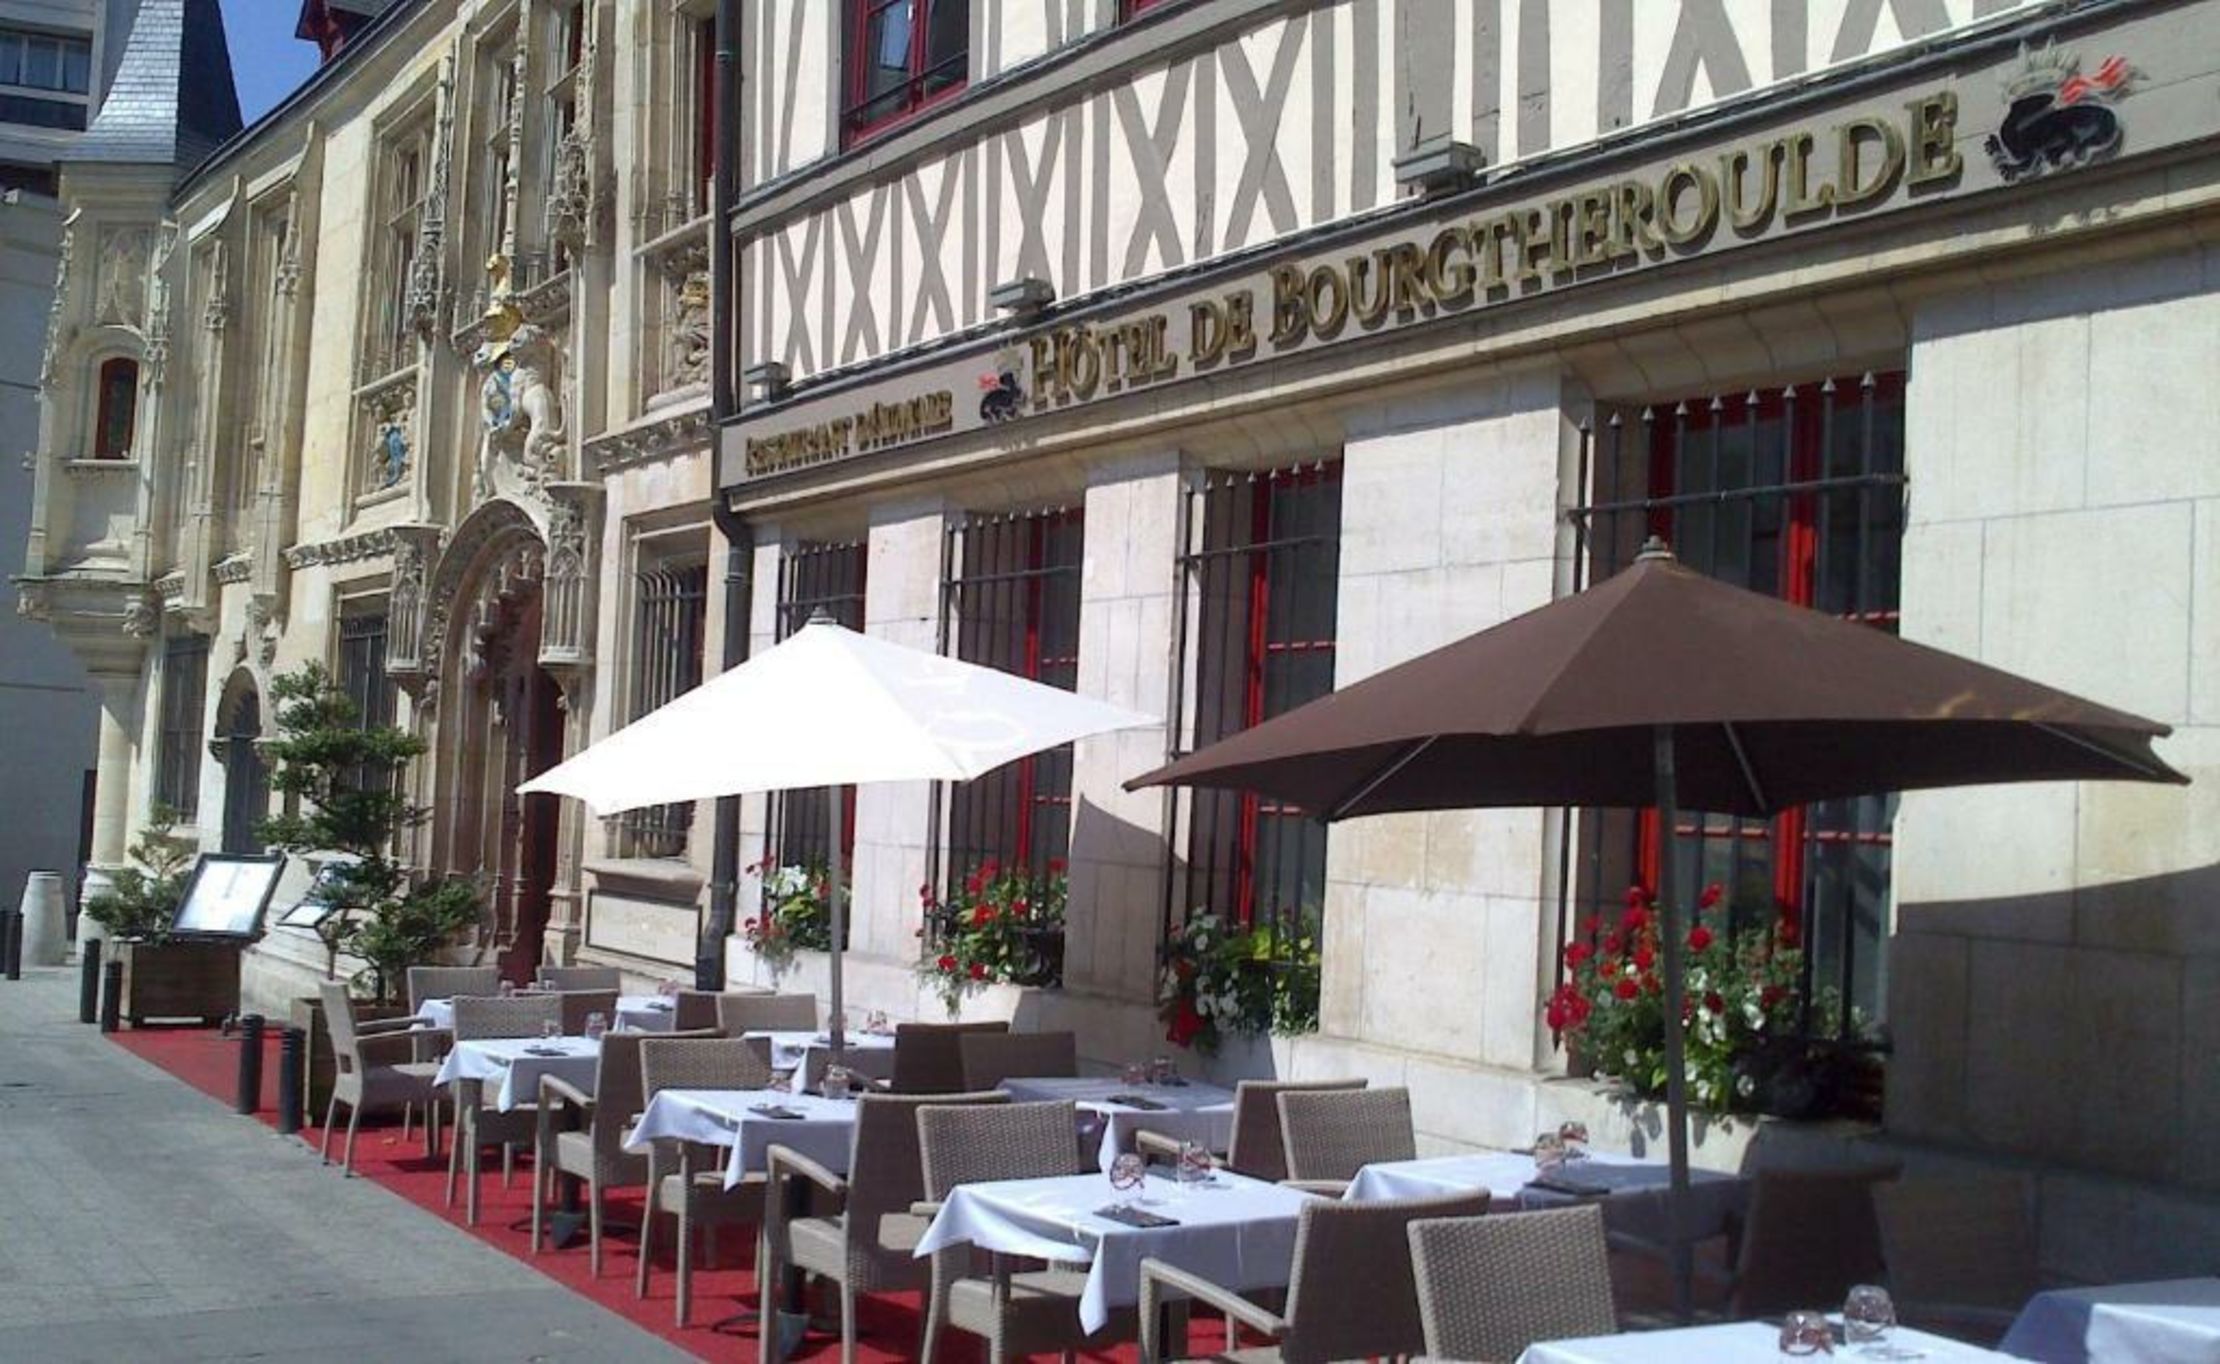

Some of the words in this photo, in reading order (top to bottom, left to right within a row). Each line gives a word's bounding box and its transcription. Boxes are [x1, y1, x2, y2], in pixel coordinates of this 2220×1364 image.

[1029, 316, 1176, 411] HÔTEL
[1188, 290, 1257, 369] DE
[1267, 90, 1963, 349] BOURGTHEROULDE
